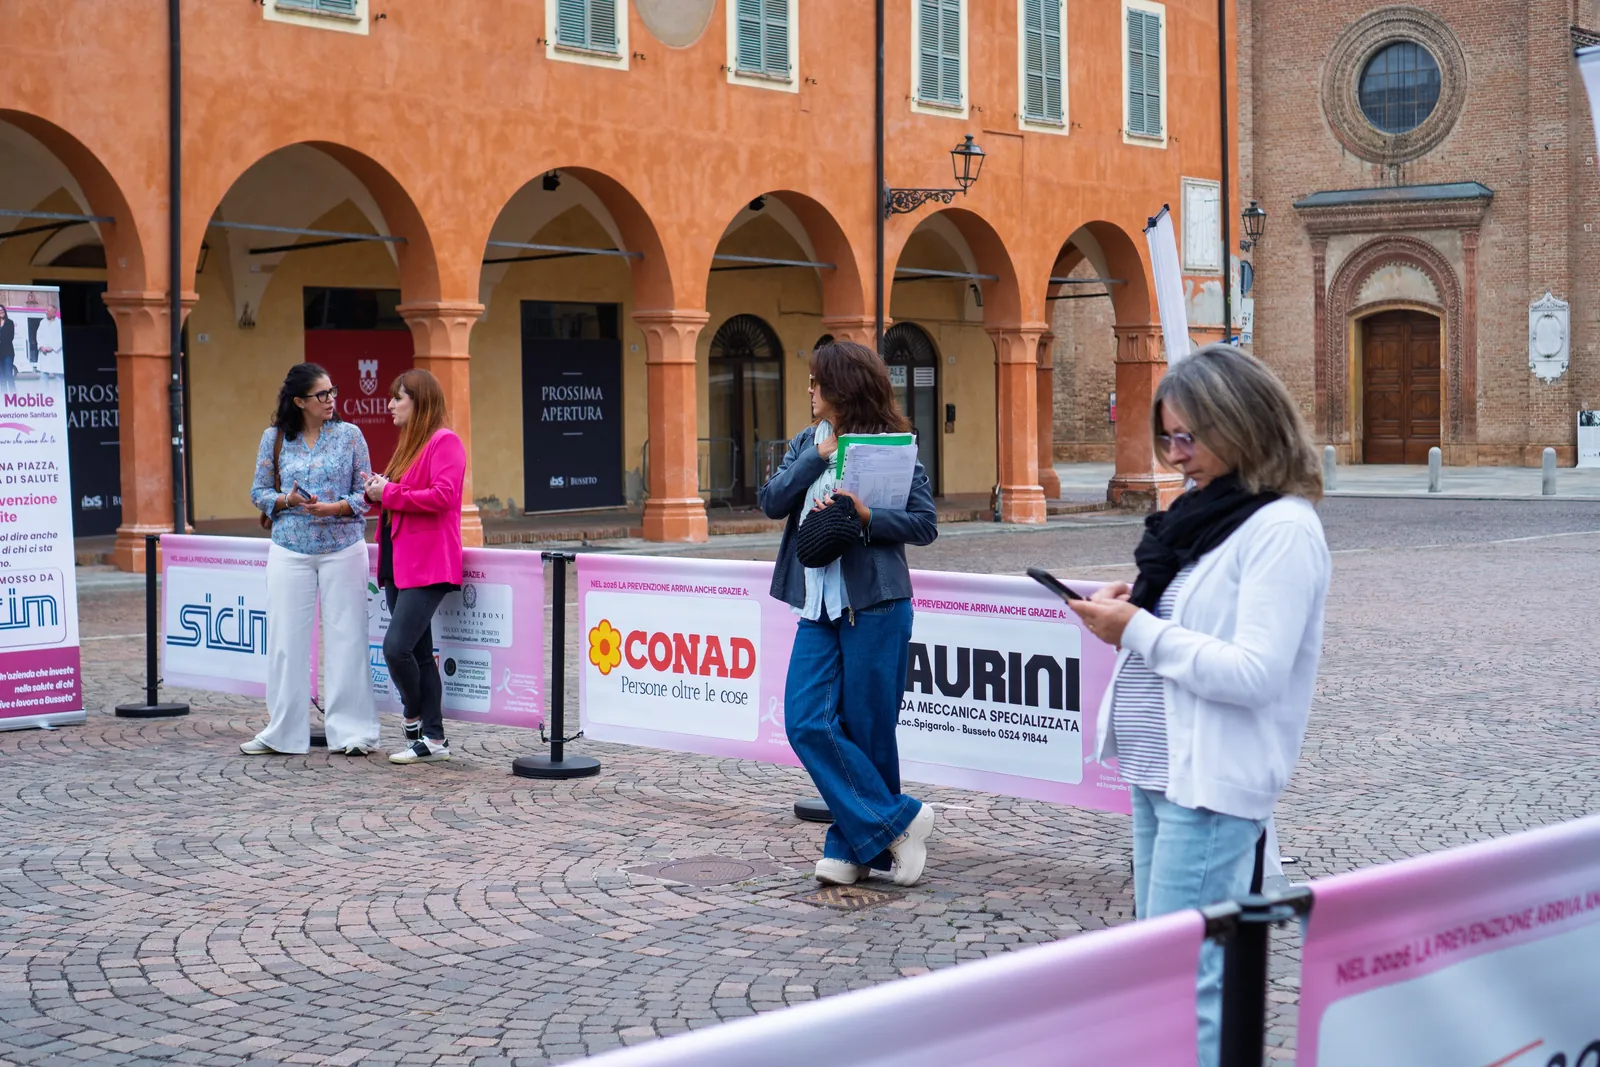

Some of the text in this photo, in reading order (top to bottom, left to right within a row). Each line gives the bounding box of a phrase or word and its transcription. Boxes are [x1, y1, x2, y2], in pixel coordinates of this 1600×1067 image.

[4, 393, 54, 407] Mobile
[541, 386, 603, 400] PROSSIMA
[541, 406, 603, 421] APERTURA
[17, 461, 59, 471] PIAZZA,
[6, 474, 59, 484] DI SALUTE
[0, 493, 58, 506] venzione
[10, 532, 28, 541] dire
[30, 531, 58, 540] anche
[2, 545, 11, 554] di
[13, 544, 27, 554] chi
[29, 544, 37, 553] ci
[40, 573, 54, 582] DA
[591, 580, 602, 588] NEL
[618, 581, 627, 590] LA
[627, 582, 670, 592] PREVENZIONE
[671, 584, 694, 593] ARRIVA
[694, 585, 717, 594] ANCHE
[718, 587, 741, 596] GRAZIE
[742, 588, 749, 596] A:
[0, 588, 58, 629] im
[472, 611, 504, 620] RIBONI
[917, 599, 969, 611] PREVENZIONE
[970, 603, 998, 613] ARRIVA
[999, 606, 1026, 616] ANCHE
[1028, 607, 1057, 618] GRAZIE
[1058, 610, 1066, 619] A:
[625, 630, 756, 679] CONAD
[36, 668, 48, 677] che
[49, 666, 74, 676] investe
[904, 642, 1080, 712] AURINI
[15, 679, 74, 693] nella salute di chi
[621, 675, 748, 705] Persone oltre le cose
[16, 699, 38, 707] lavora
[917, 702, 987, 721] MECCANICA
[990, 709, 1080, 732] SPECIALIZZATA
[962, 724, 996, 738] Busseto
[998, 729, 1020, 741] 0524
[1022, 732, 1048, 744] 91844
[1336, 957, 1368, 984] NEL
[1415, 937, 1431, 964] LA
[1435, 909, 1533, 953] PREVENZIONE
[1537, 897, 1583, 926] ARRIVA
